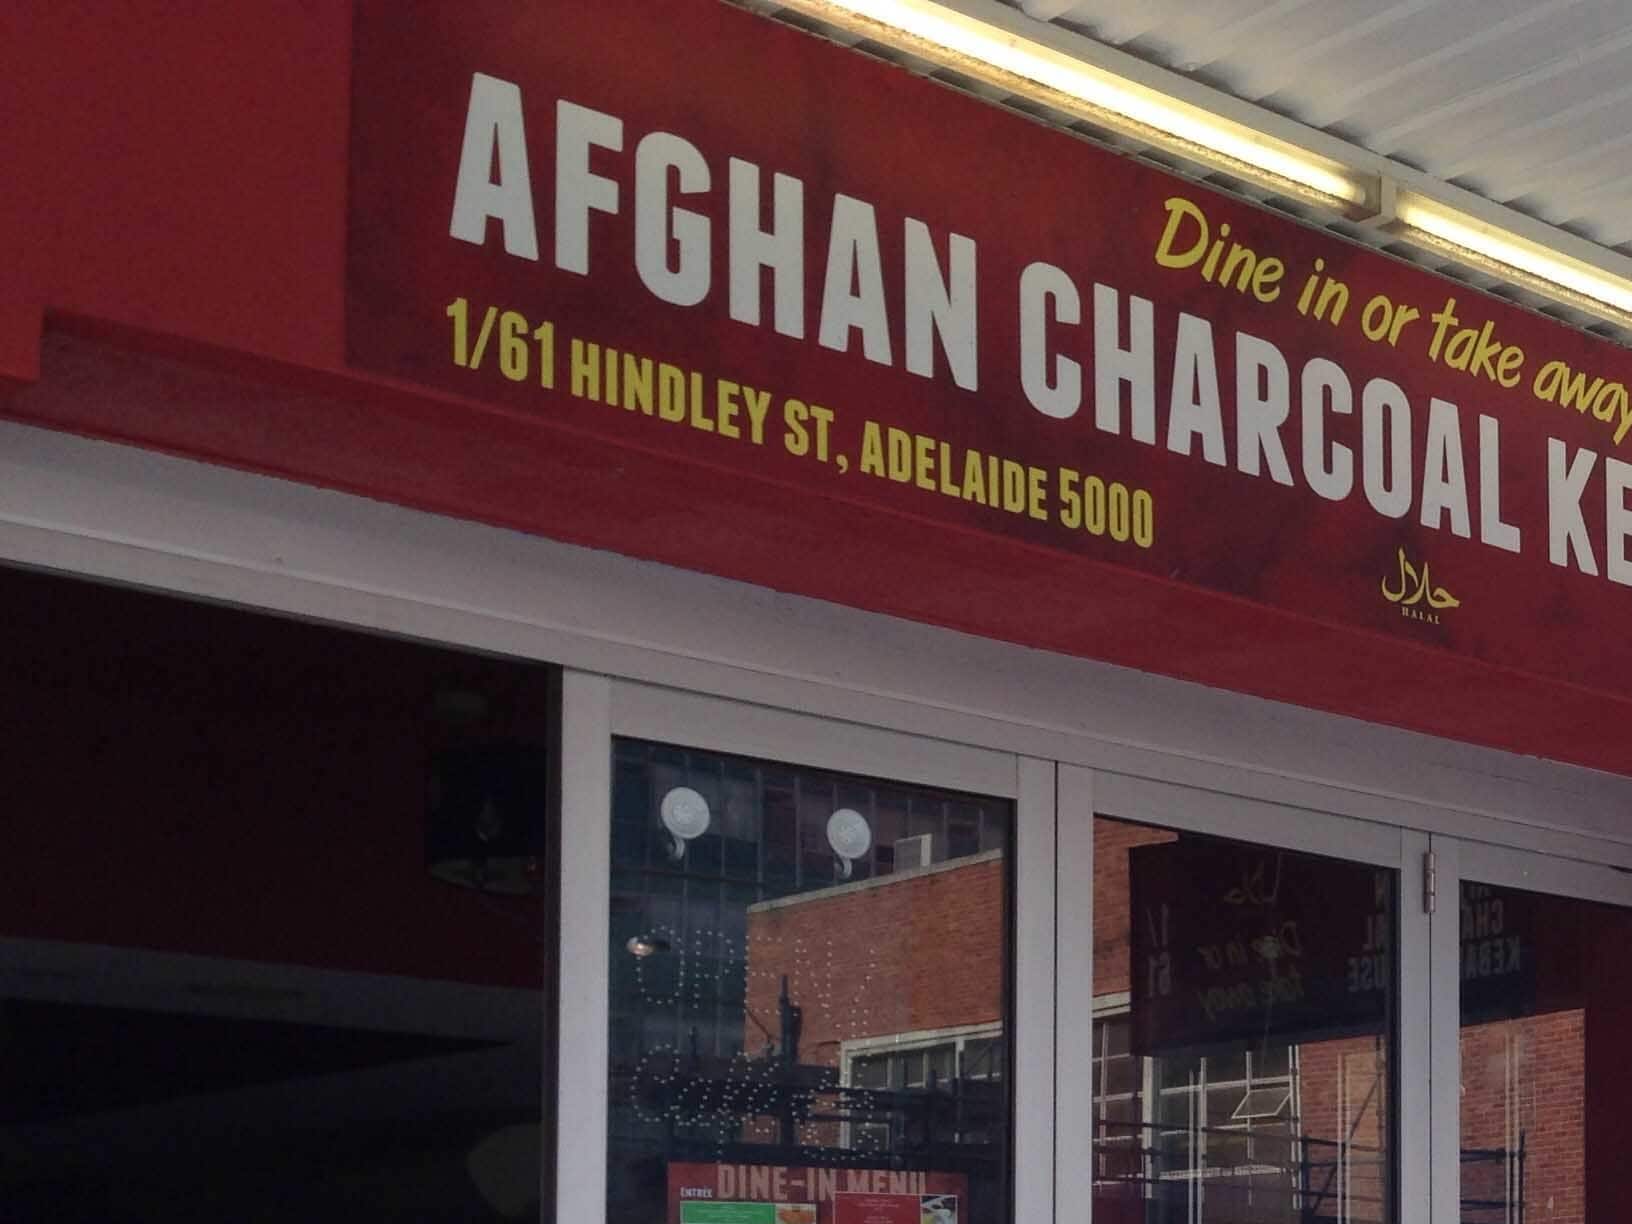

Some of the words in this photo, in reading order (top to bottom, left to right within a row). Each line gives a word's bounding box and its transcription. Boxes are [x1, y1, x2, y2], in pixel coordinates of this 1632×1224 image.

[449, 72, 977, 393] AFGHAN
[1020, 261, 1520, 553] CHARCOAL
[1155, 197, 1283, 302] Dine
[1297, 259, 1349, 326] in
[1361, 294, 1419, 346] or
[1428, 298, 1524, 388] take
[447, 298, 554, 389] 1/61
[571, 339, 771, 444] HINDLEY
[784, 400, 848, 473] ST,
[860, 420, 1047, 520] ADELAIDE
[1060, 469, 1153, 549] 5000
[1401, 607, 1440, 625] HALAL
[717, 1164, 837, 1200] DINE-IN
